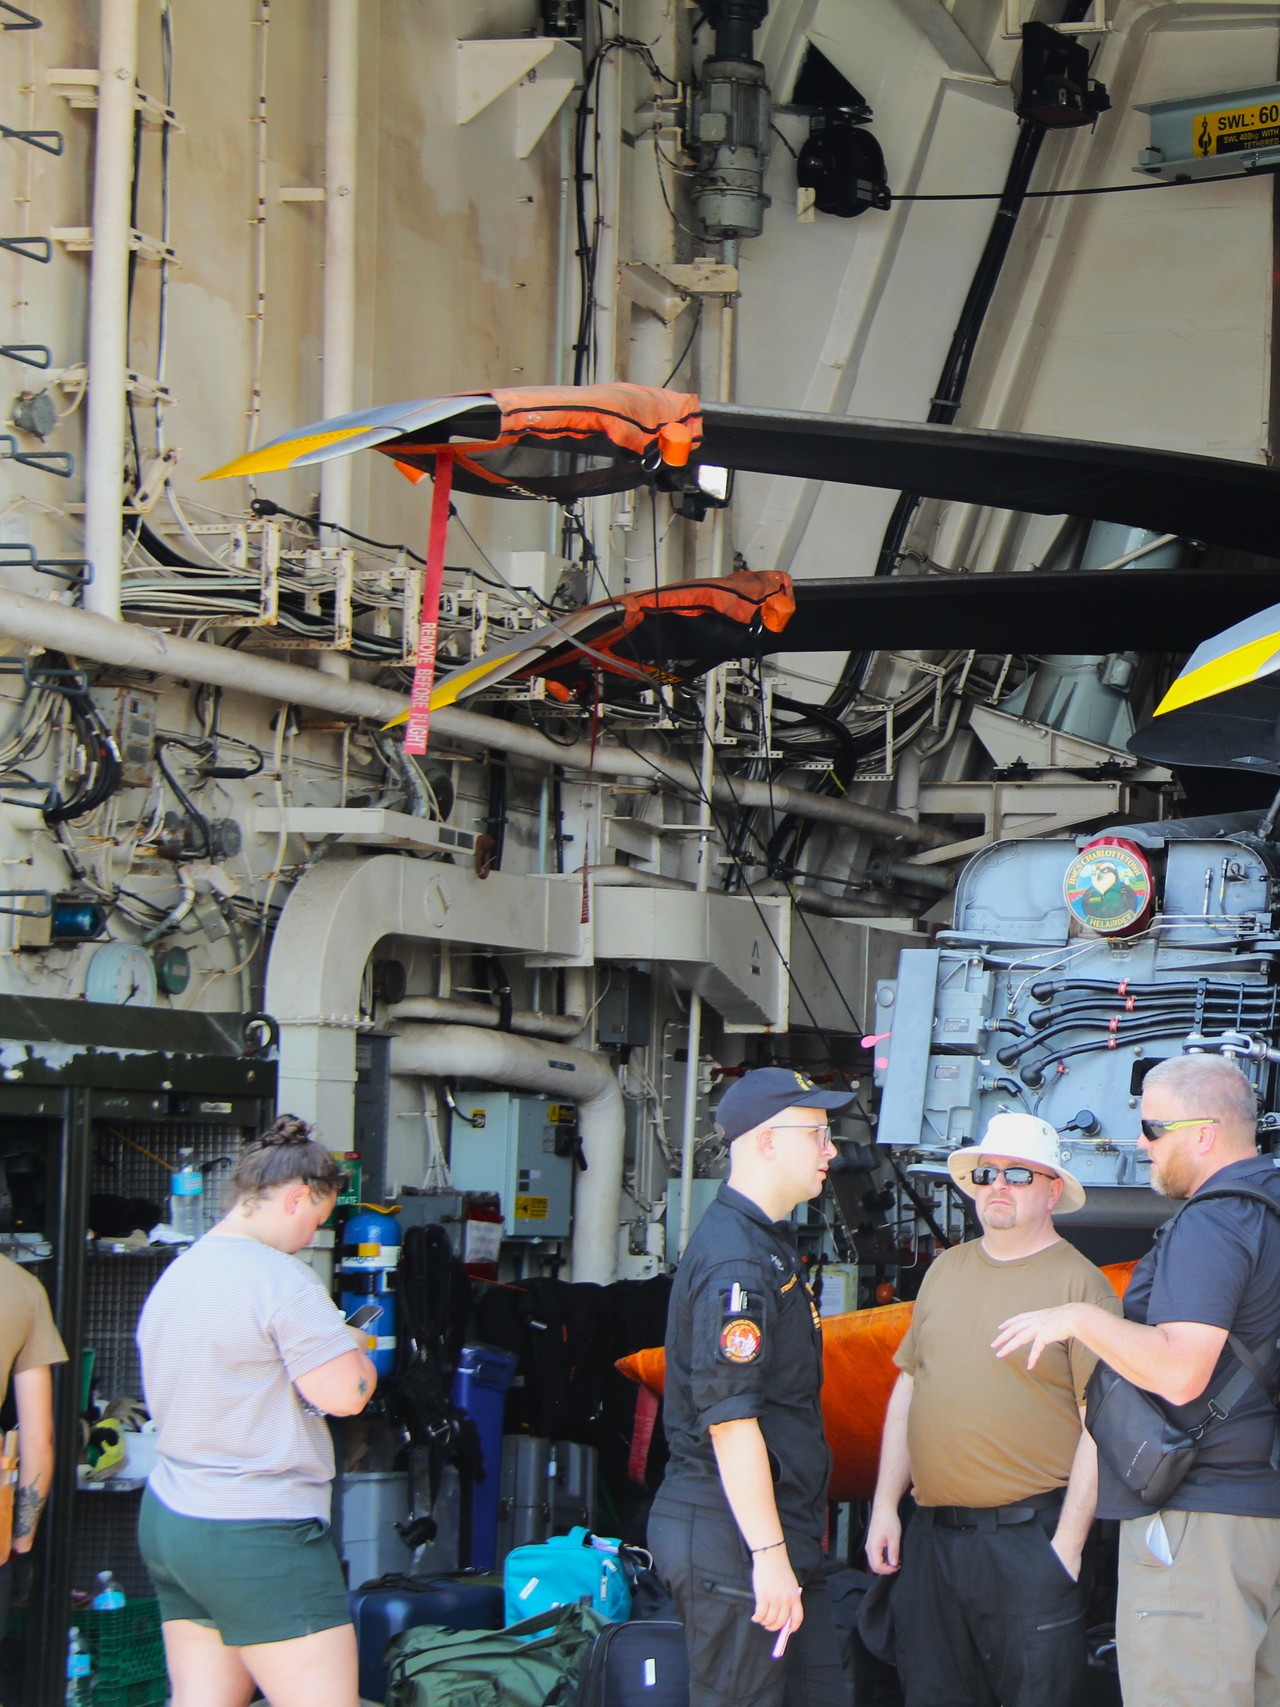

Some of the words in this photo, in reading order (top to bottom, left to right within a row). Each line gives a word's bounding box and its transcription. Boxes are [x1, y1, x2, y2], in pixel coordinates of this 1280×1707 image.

[1218, 113, 1255, 131] SWL:
[1224, 135, 1239, 144] SWL
[1261, 129, 1279, 137] WITH
[1243, 137, 1280, 150] TETHERED
[418, 622, 437, 664] REMOVE
[411, 668, 434, 709] BEFORE
[406, 712, 428, 748] FLIGHT
[1068, 863, 1082, 885] HMCS
[1082, 849, 1142, 876] CHARLOTTETOWN
[1089, 913, 1132, 928] HELAIRDET
